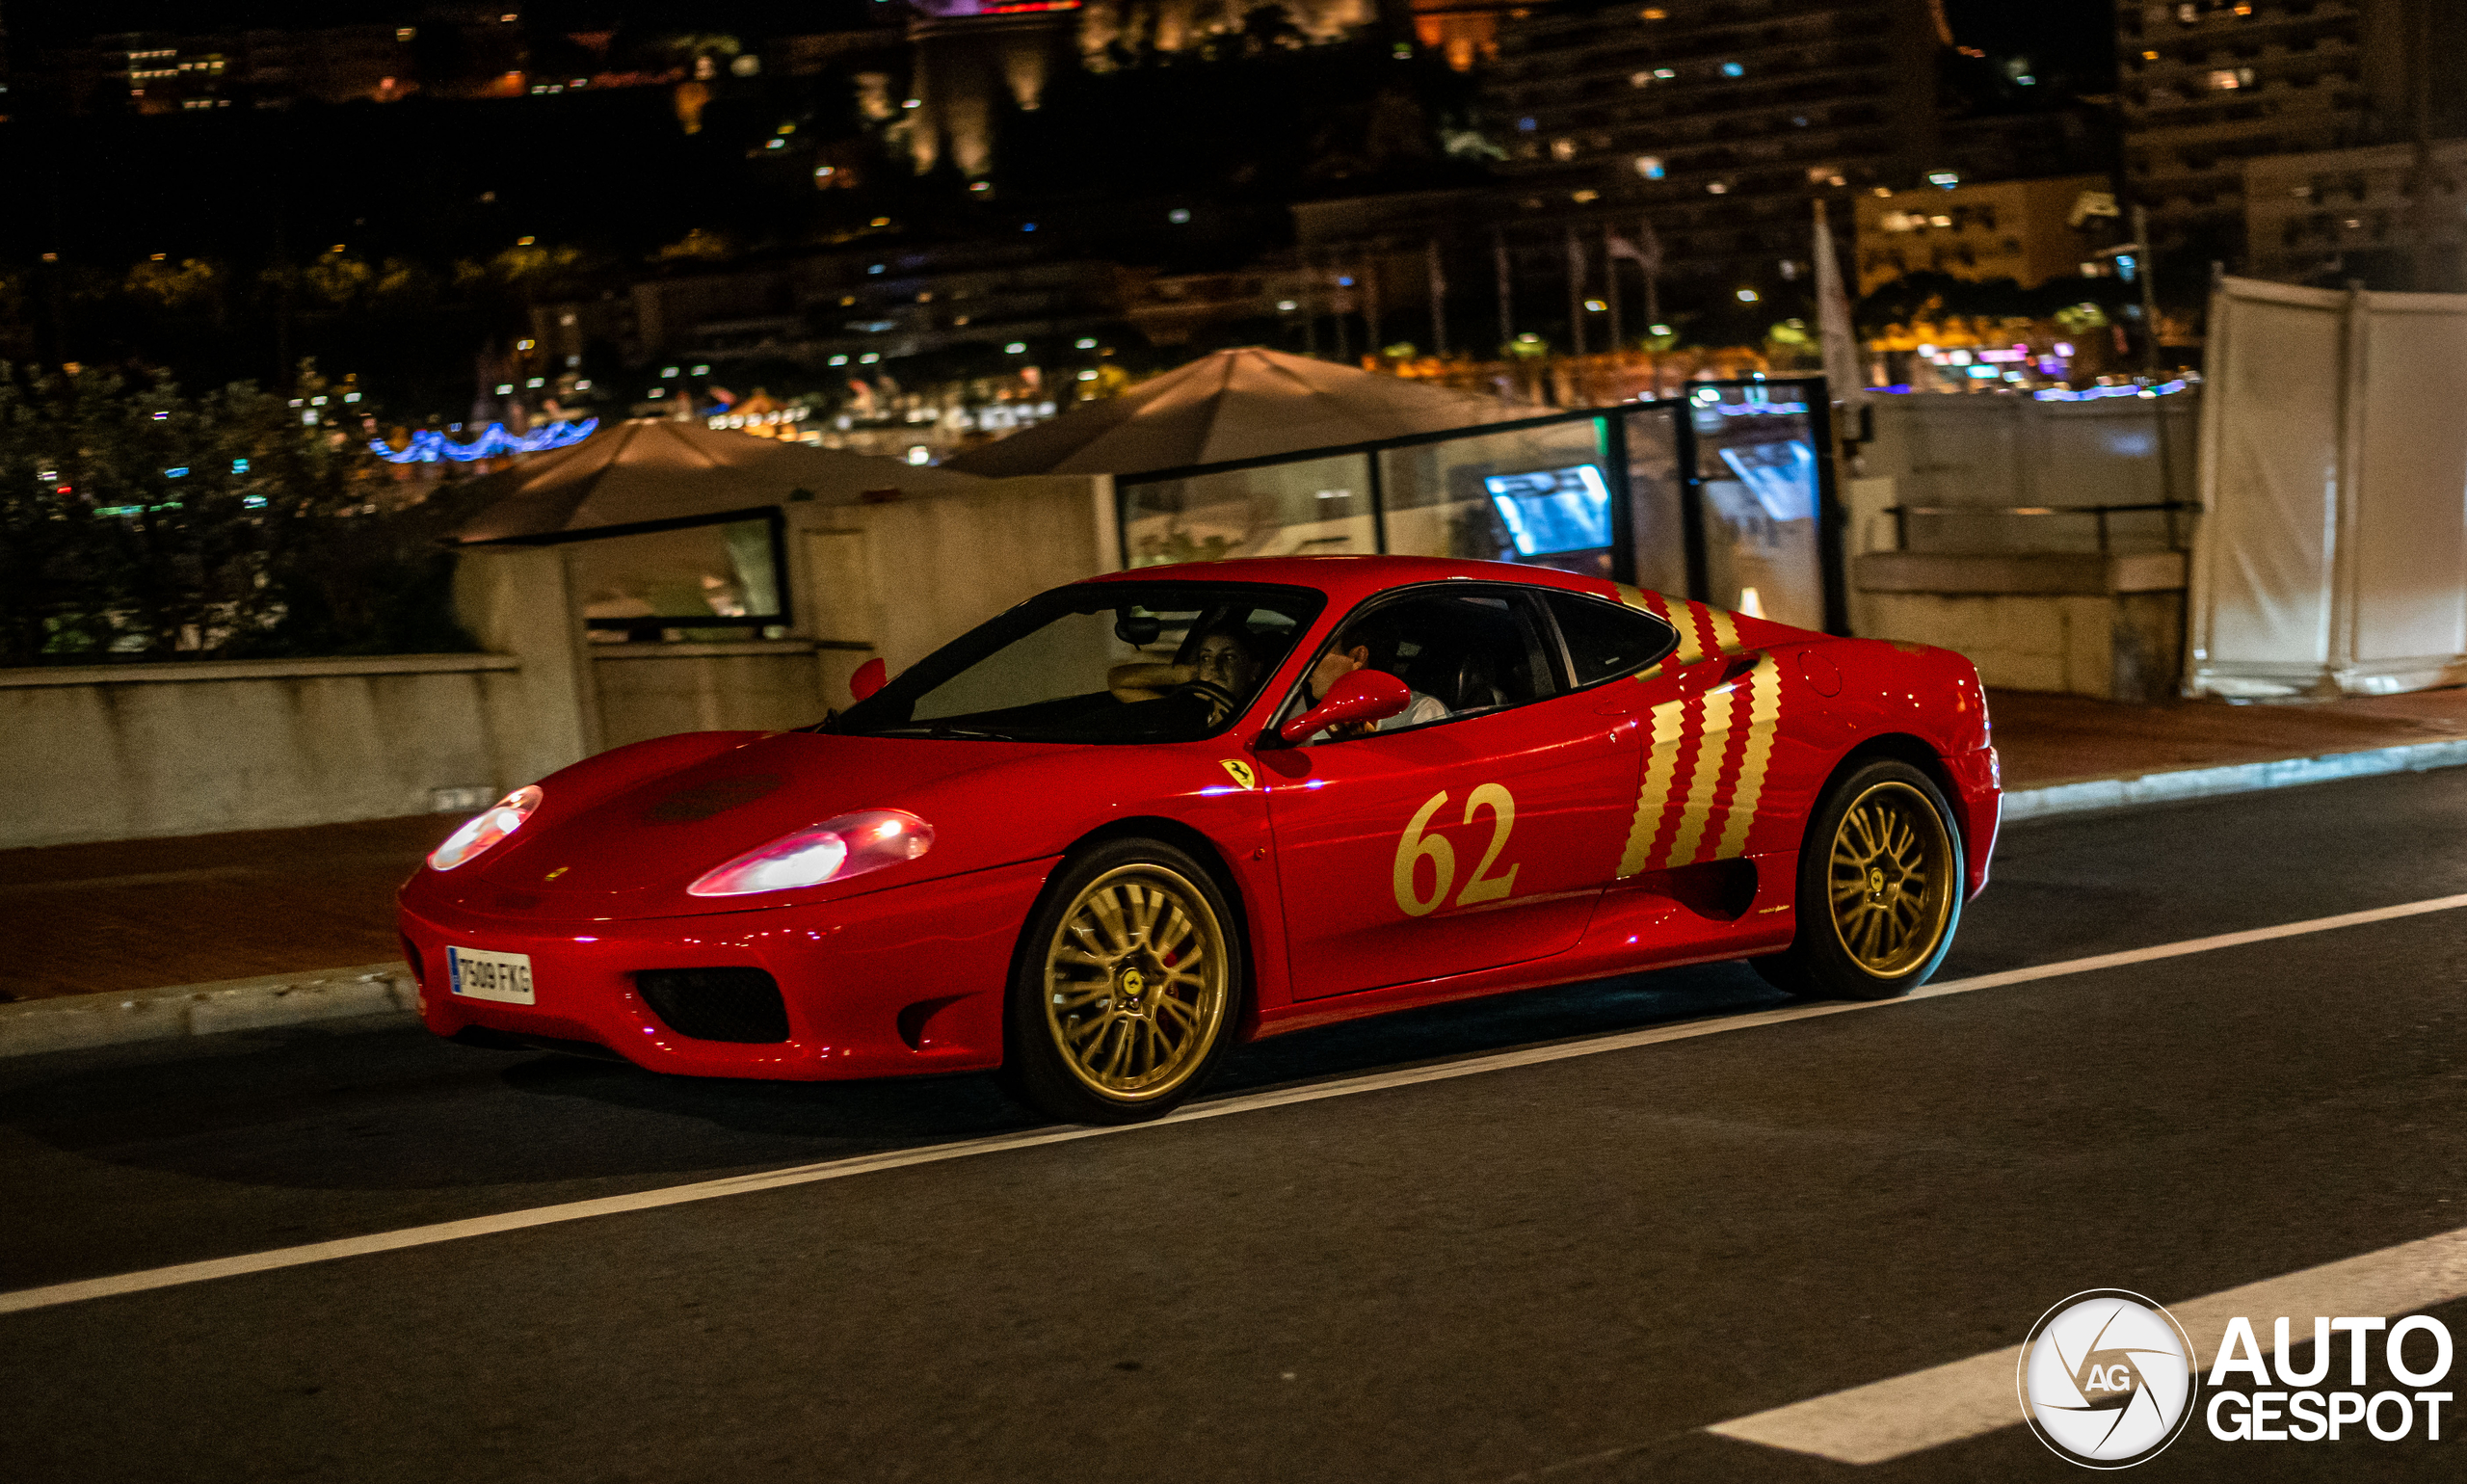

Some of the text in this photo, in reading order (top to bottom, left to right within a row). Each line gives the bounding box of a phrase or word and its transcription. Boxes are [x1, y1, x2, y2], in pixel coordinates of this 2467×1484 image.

[1393, 782, 1520, 916] 62
[459, 959, 530, 993] 7509 FKG
